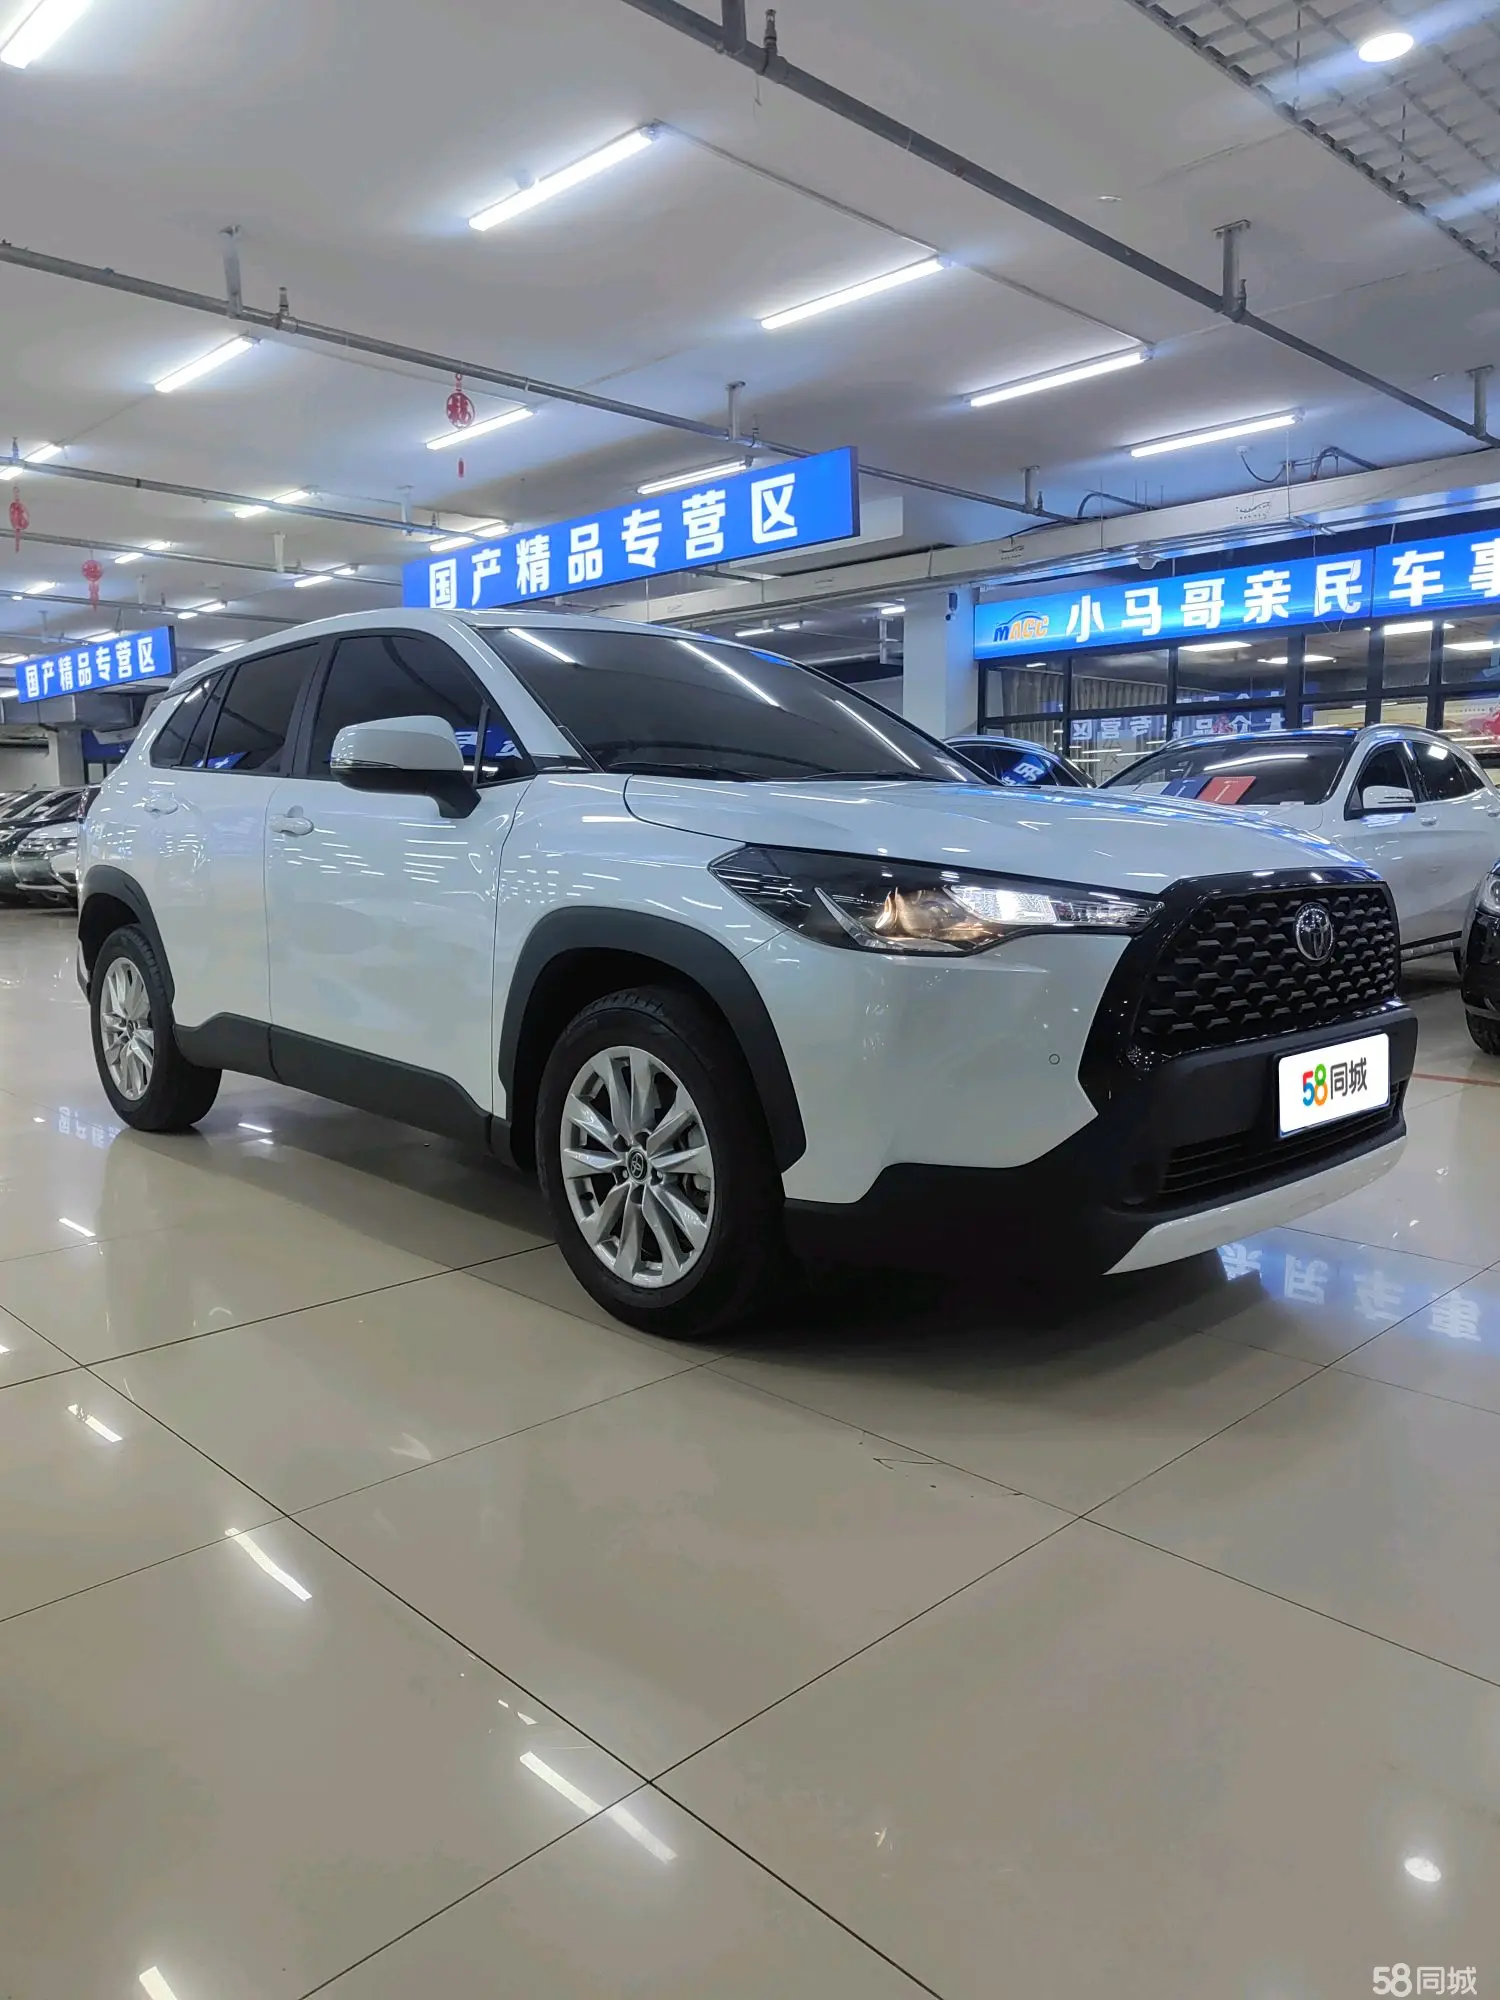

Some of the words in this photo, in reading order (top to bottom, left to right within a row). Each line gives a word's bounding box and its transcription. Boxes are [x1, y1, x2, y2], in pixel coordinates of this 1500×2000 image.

[428, 472, 798, 609] 国产精品专营区
[25, 636, 156, 698] 国产精品专营区
